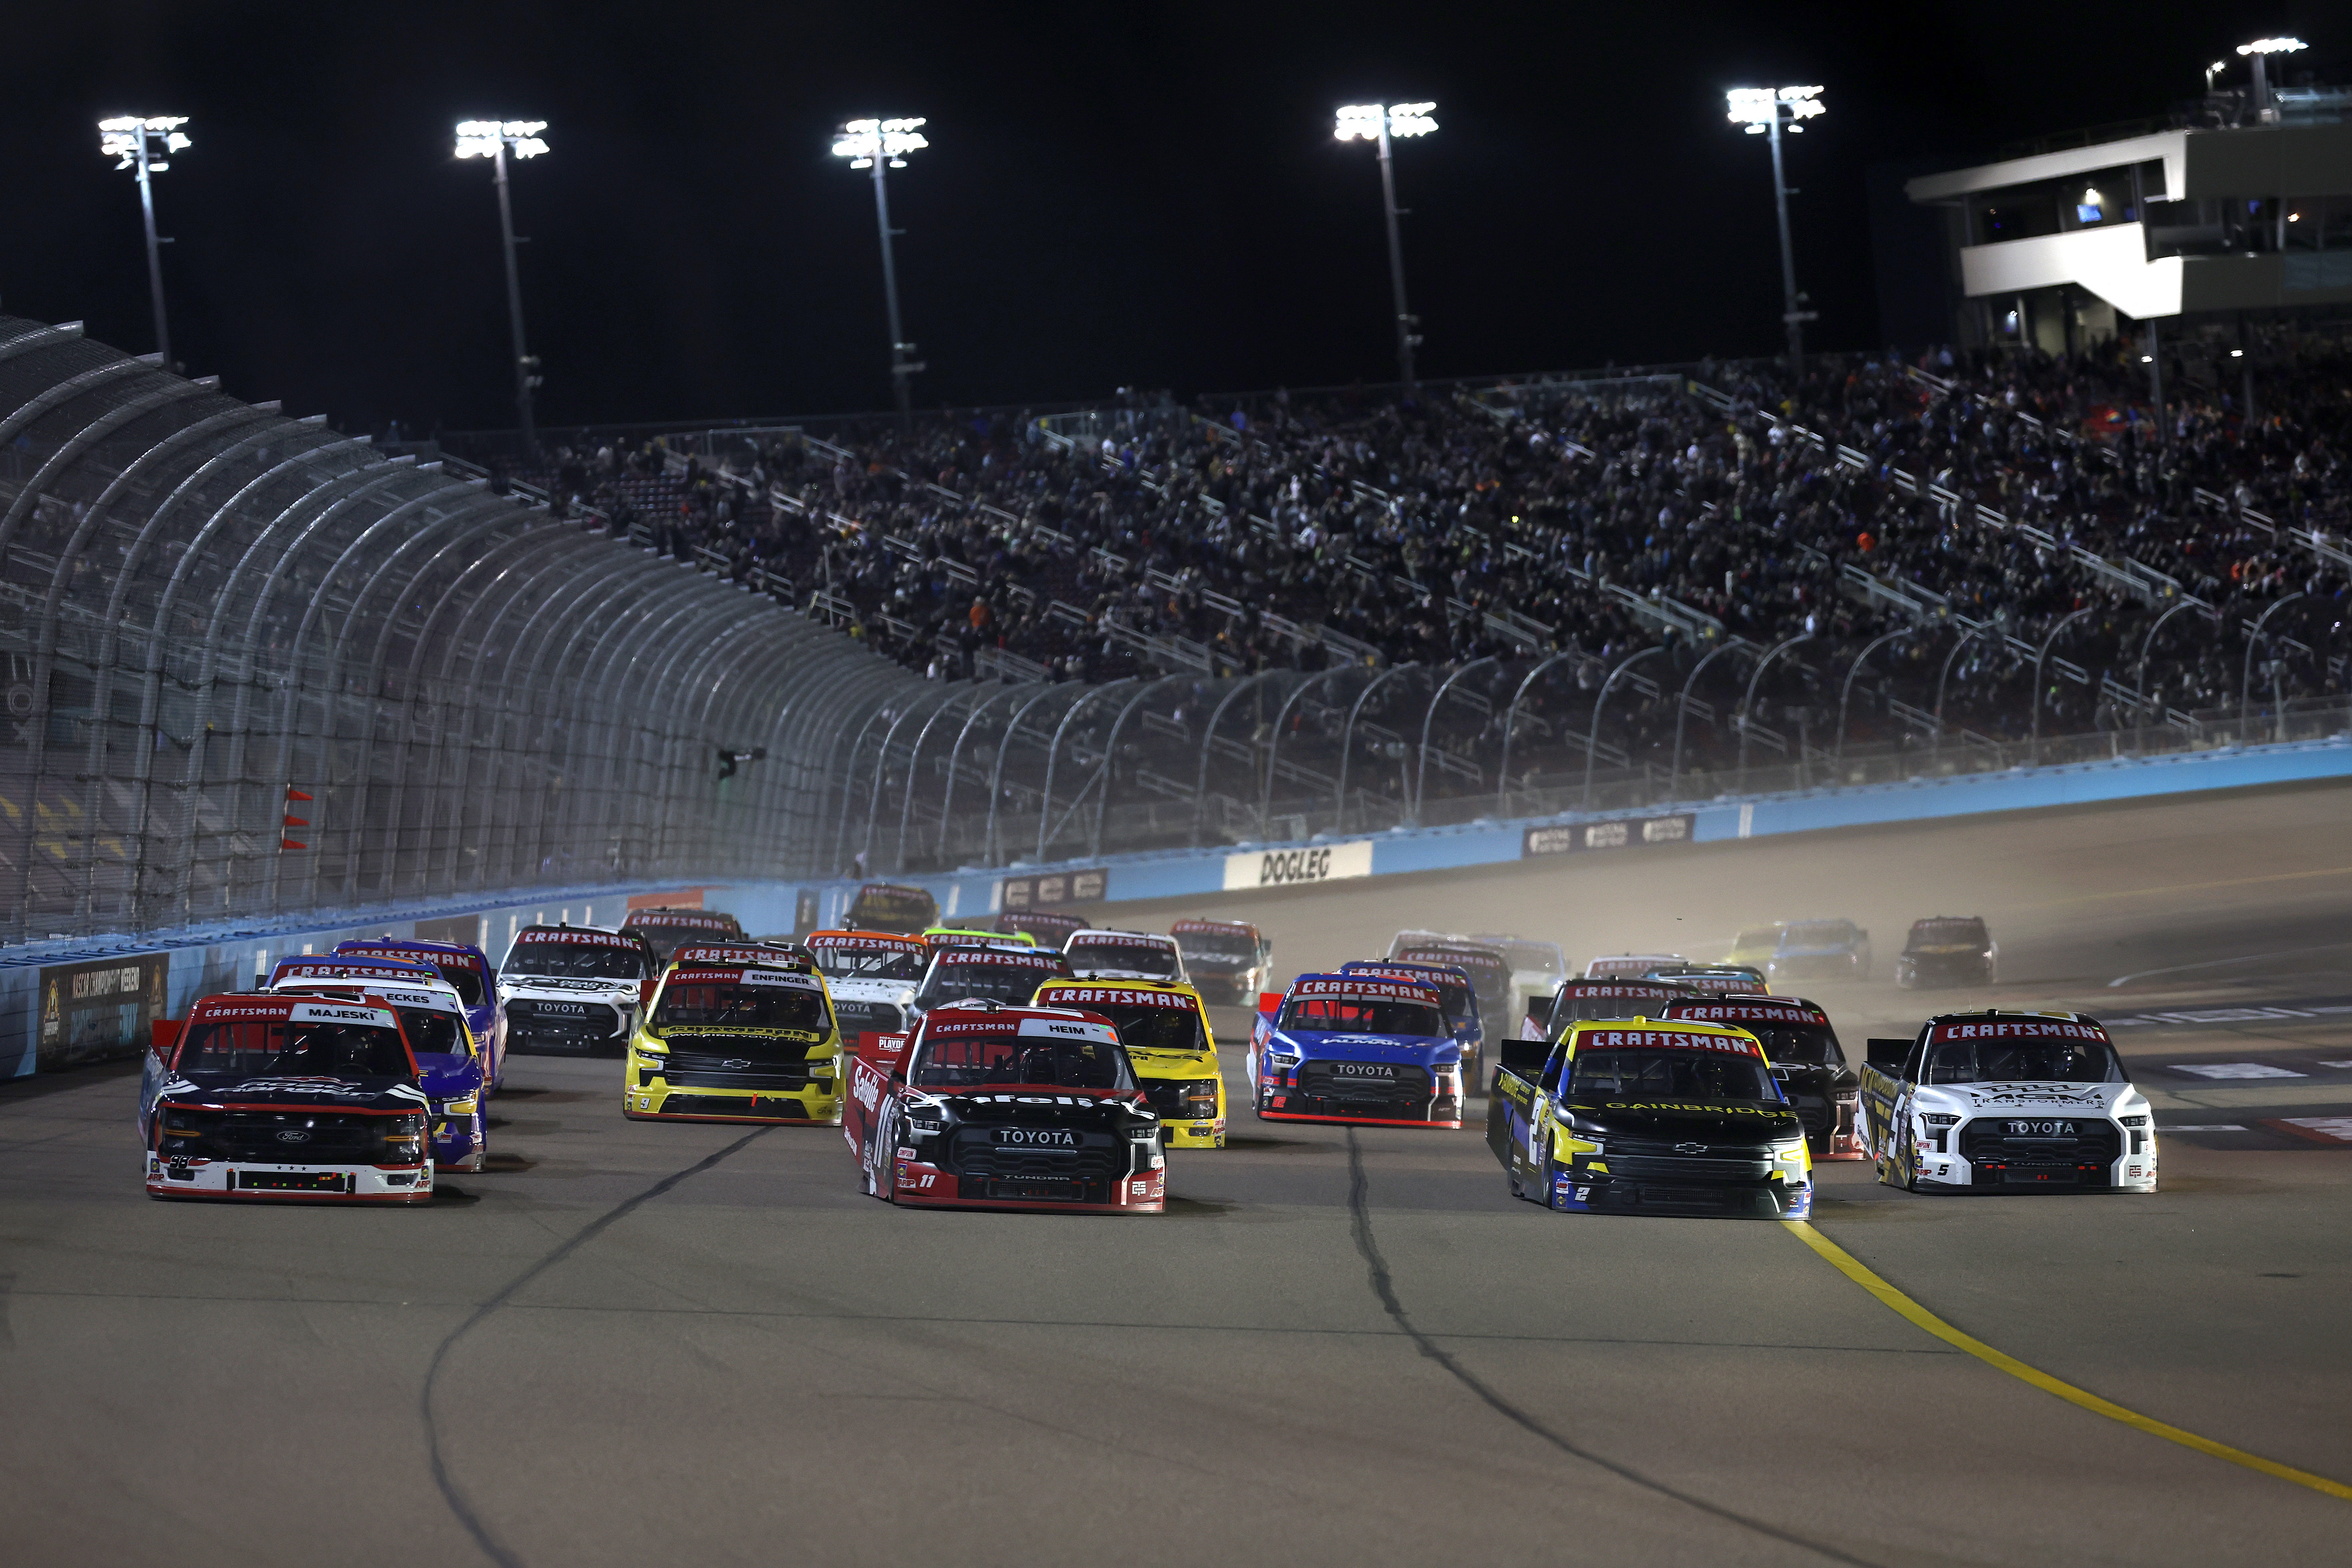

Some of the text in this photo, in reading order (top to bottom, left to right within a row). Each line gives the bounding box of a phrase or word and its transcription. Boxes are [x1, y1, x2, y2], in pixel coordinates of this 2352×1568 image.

[1262, 849, 1331, 883] DOGLEG
[632, 915, 723, 929] CRAFTSMAN
[525, 932, 633, 948] CRAFTSMAN
[815, 937, 917, 952] CRAFTSMAN
[1077, 935, 1168, 950] CRAFTSMAN
[946, 952, 1058, 970] CRAFTSMAN
[752, 974, 810, 985] ENFINGER
[1302, 982, 1426, 1000] CRAFTSMAN
[386, 993, 429, 1004] ECKES
[1049, 989, 1187, 1008] CRAFTSMAN
[206, 1008, 375, 1021] CRAFTSMAN MAJESKI
[537, 1003, 585, 1013] TOYOTA
[833, 1003, 870, 1013] OYOTA
[1682, 1007, 1815, 1023] CRAFTSMAN
[936, 1023, 1085, 1035] CRAFTSMAN HEIM
[1947, 1024, 2097, 1040] CRAFTSMAN
[1593, 1031, 1748, 1054] CRAFTSMAN
[1338, 1065, 1393, 1076] TOYOTA
[853, 1065, 879, 1113] Safelite
[640, 1097, 651, 1110] 9
[909, 1094, 1156, 1120] Safelite
[1272, 1096, 1286, 1108] 52
[1606, 1102, 1798, 1119] GAINBRIDGE
[2008, 1122, 2075, 1134] TOYOTA
[1000, 1130, 1074, 1145] TOYOTA
[169, 1155, 193, 1169] 98
[1937, 1164, 1950, 1176] 5
[920, 1174, 936, 1187] 11
[1574, 1187, 1591, 1201] 2
